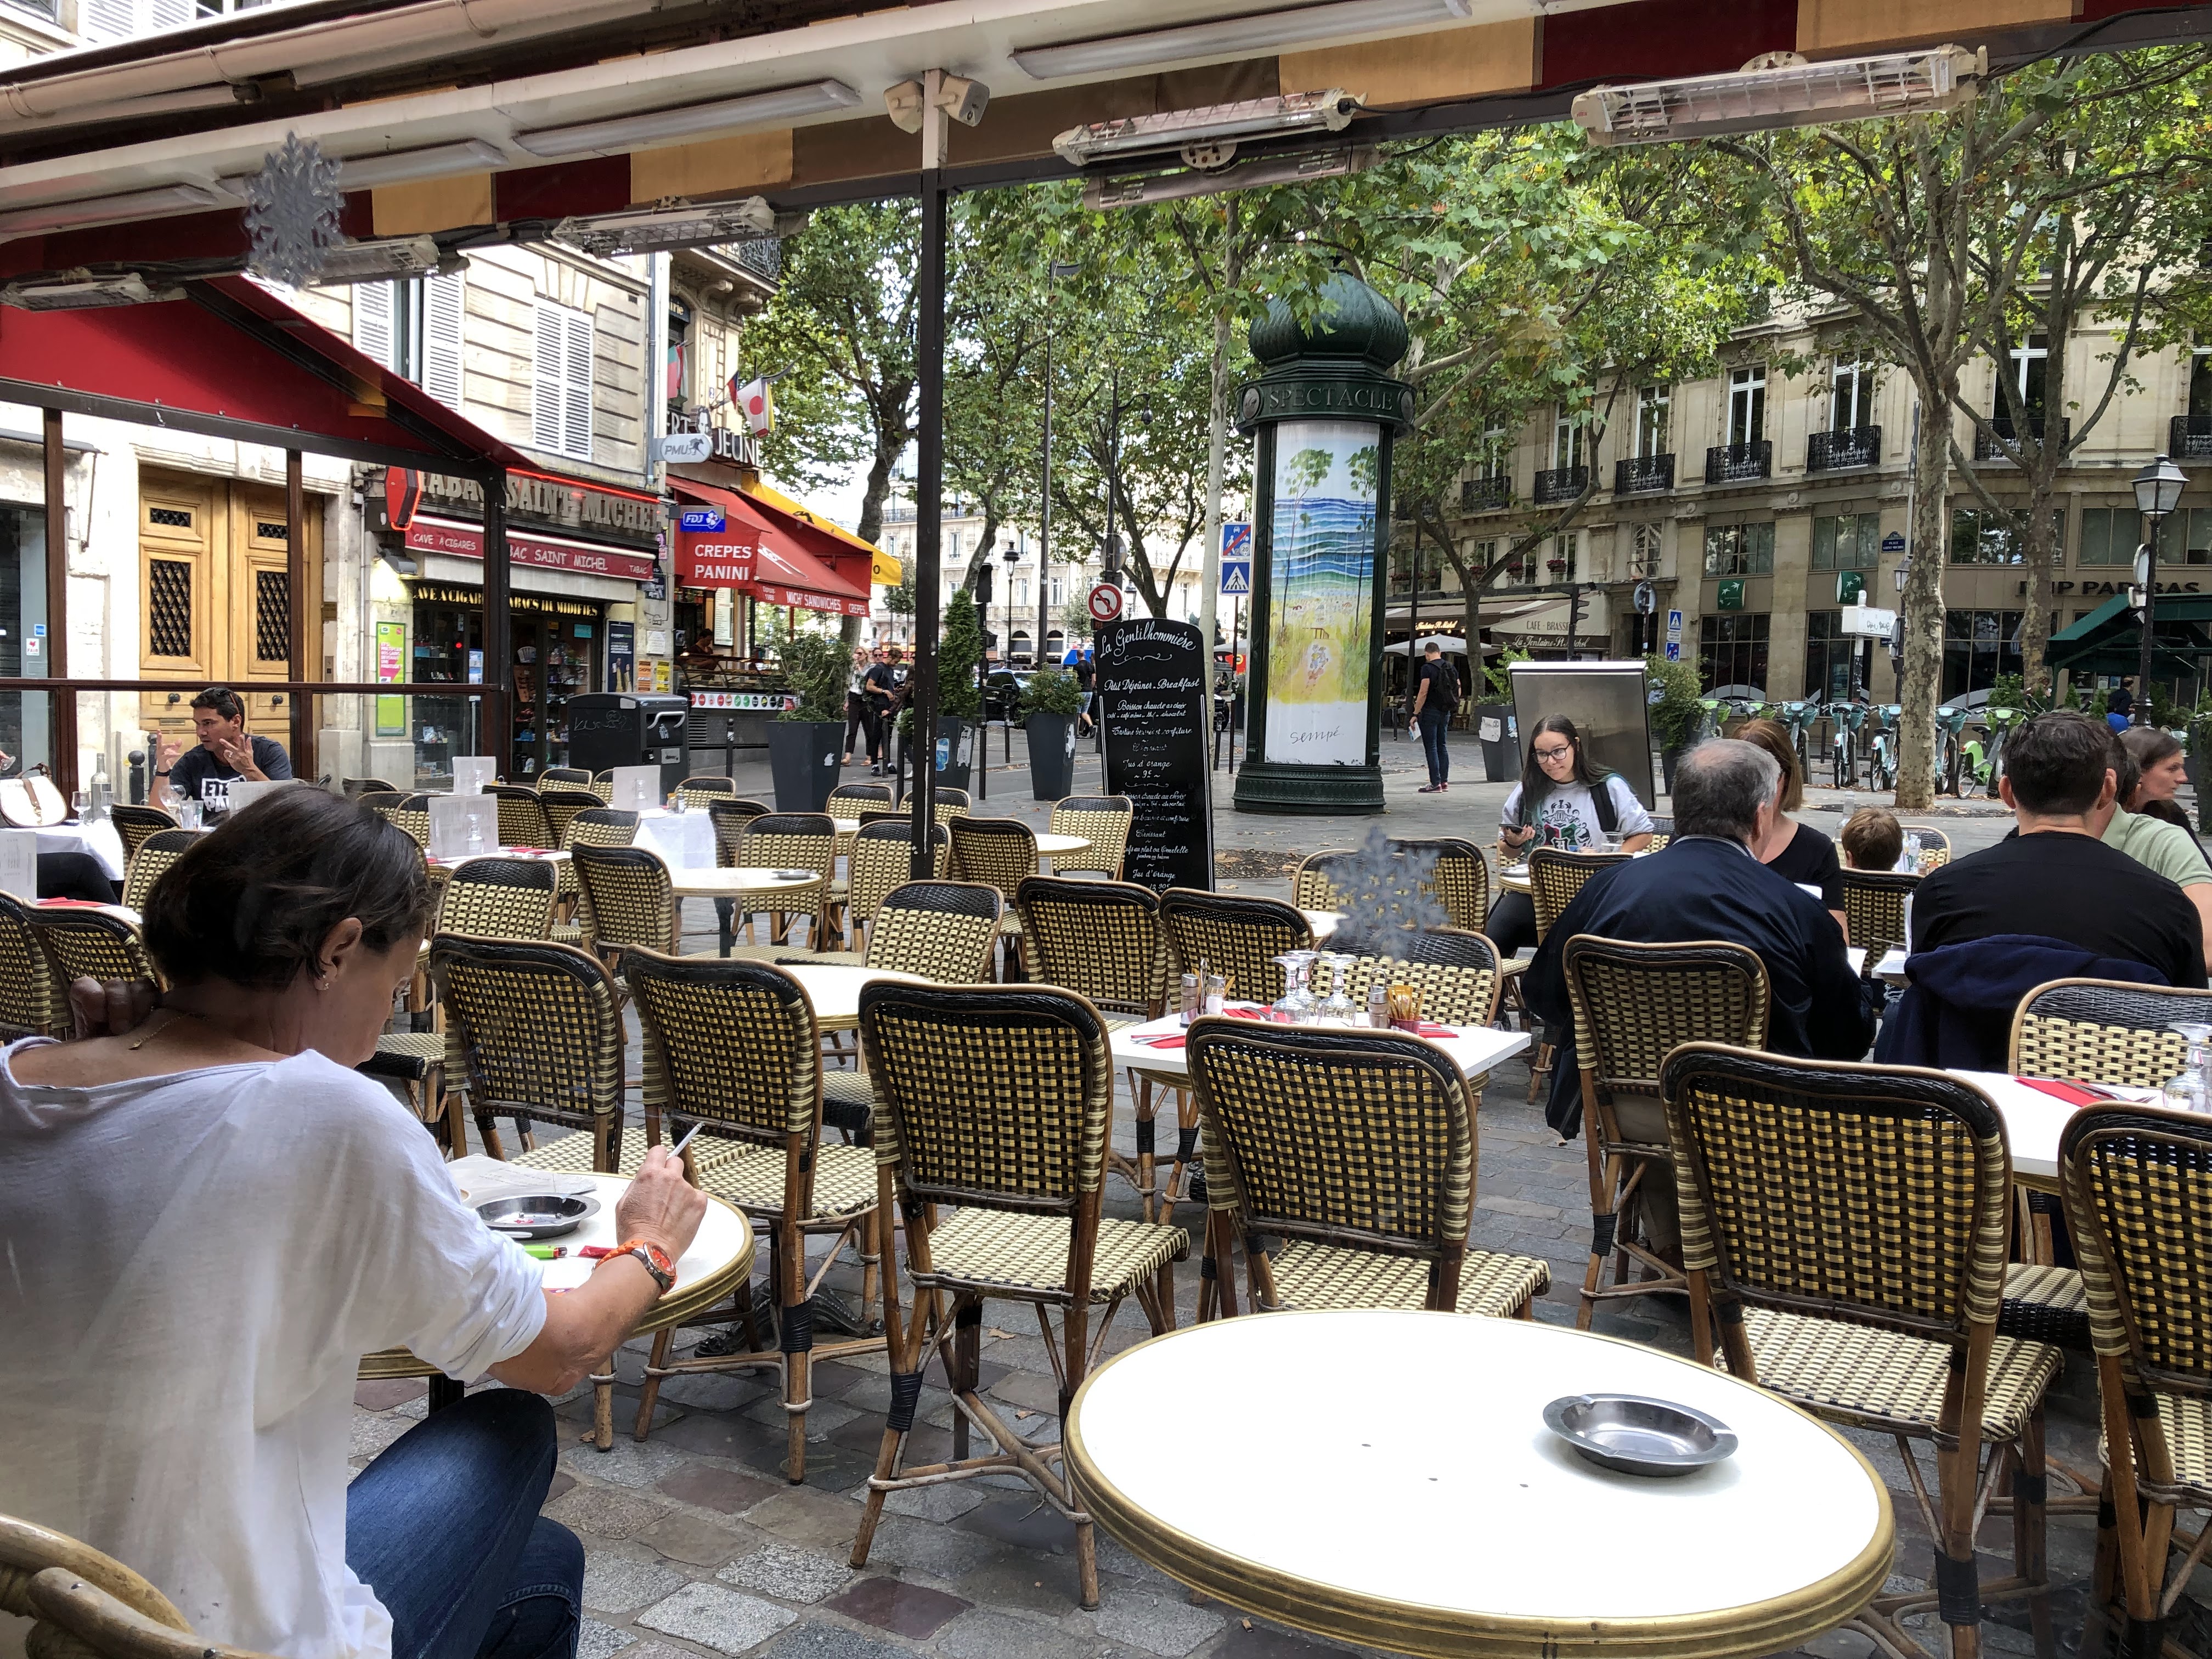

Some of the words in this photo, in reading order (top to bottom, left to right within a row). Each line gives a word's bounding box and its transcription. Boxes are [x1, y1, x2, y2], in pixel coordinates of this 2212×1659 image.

[1269, 387, 1392, 410] SPECTACLE
[664, 445, 688, 455] PMU
[715, 428, 764, 467] JEUNE
[505, 476, 572, 518] SAINT
[581, 493, 661, 533] MICHEL
[685, 514, 703, 523] FDJ
[414, 534, 433, 544] CAVE
[445, 538, 476, 550] CIGARES
[695, 544, 752, 559] CREPES
[510, 544, 527, 559] BAC
[534, 549, 567, 565] SAINT
[574, 555, 608, 571] MICHEL
[629, 565, 648, 574] TABAC
[695, 565, 749, 580] PANINI
[2083, 581, 2200, 595] PARBAS
[448, 589, 484, 605] CIGAR
[509, 596, 539, 610] ABACS
[804, 594, 841, 611] SANDWICHES
[848, 603, 866, 614] CREPES
[1547, 622, 1578, 631] BRASSEE
[1100, 635, 1112, 658] La
[1114, 620, 1196, 657] Gentilhommière
[1564, 637, 1590, 647] ichel
[1157, 678, 1200, 692] Breakfast
[1117, 699, 1142, 710] Boisson
[1143, 701, 1165, 710] chaude
[1123, 759, 1135, 770] Jus
[1136, 829, 1166, 838] Croissant
[1125, 845, 1134, 855] ufs
[1161, 845, 1189, 854] Omelette
[1132, 869, 1143, 879] Jus
